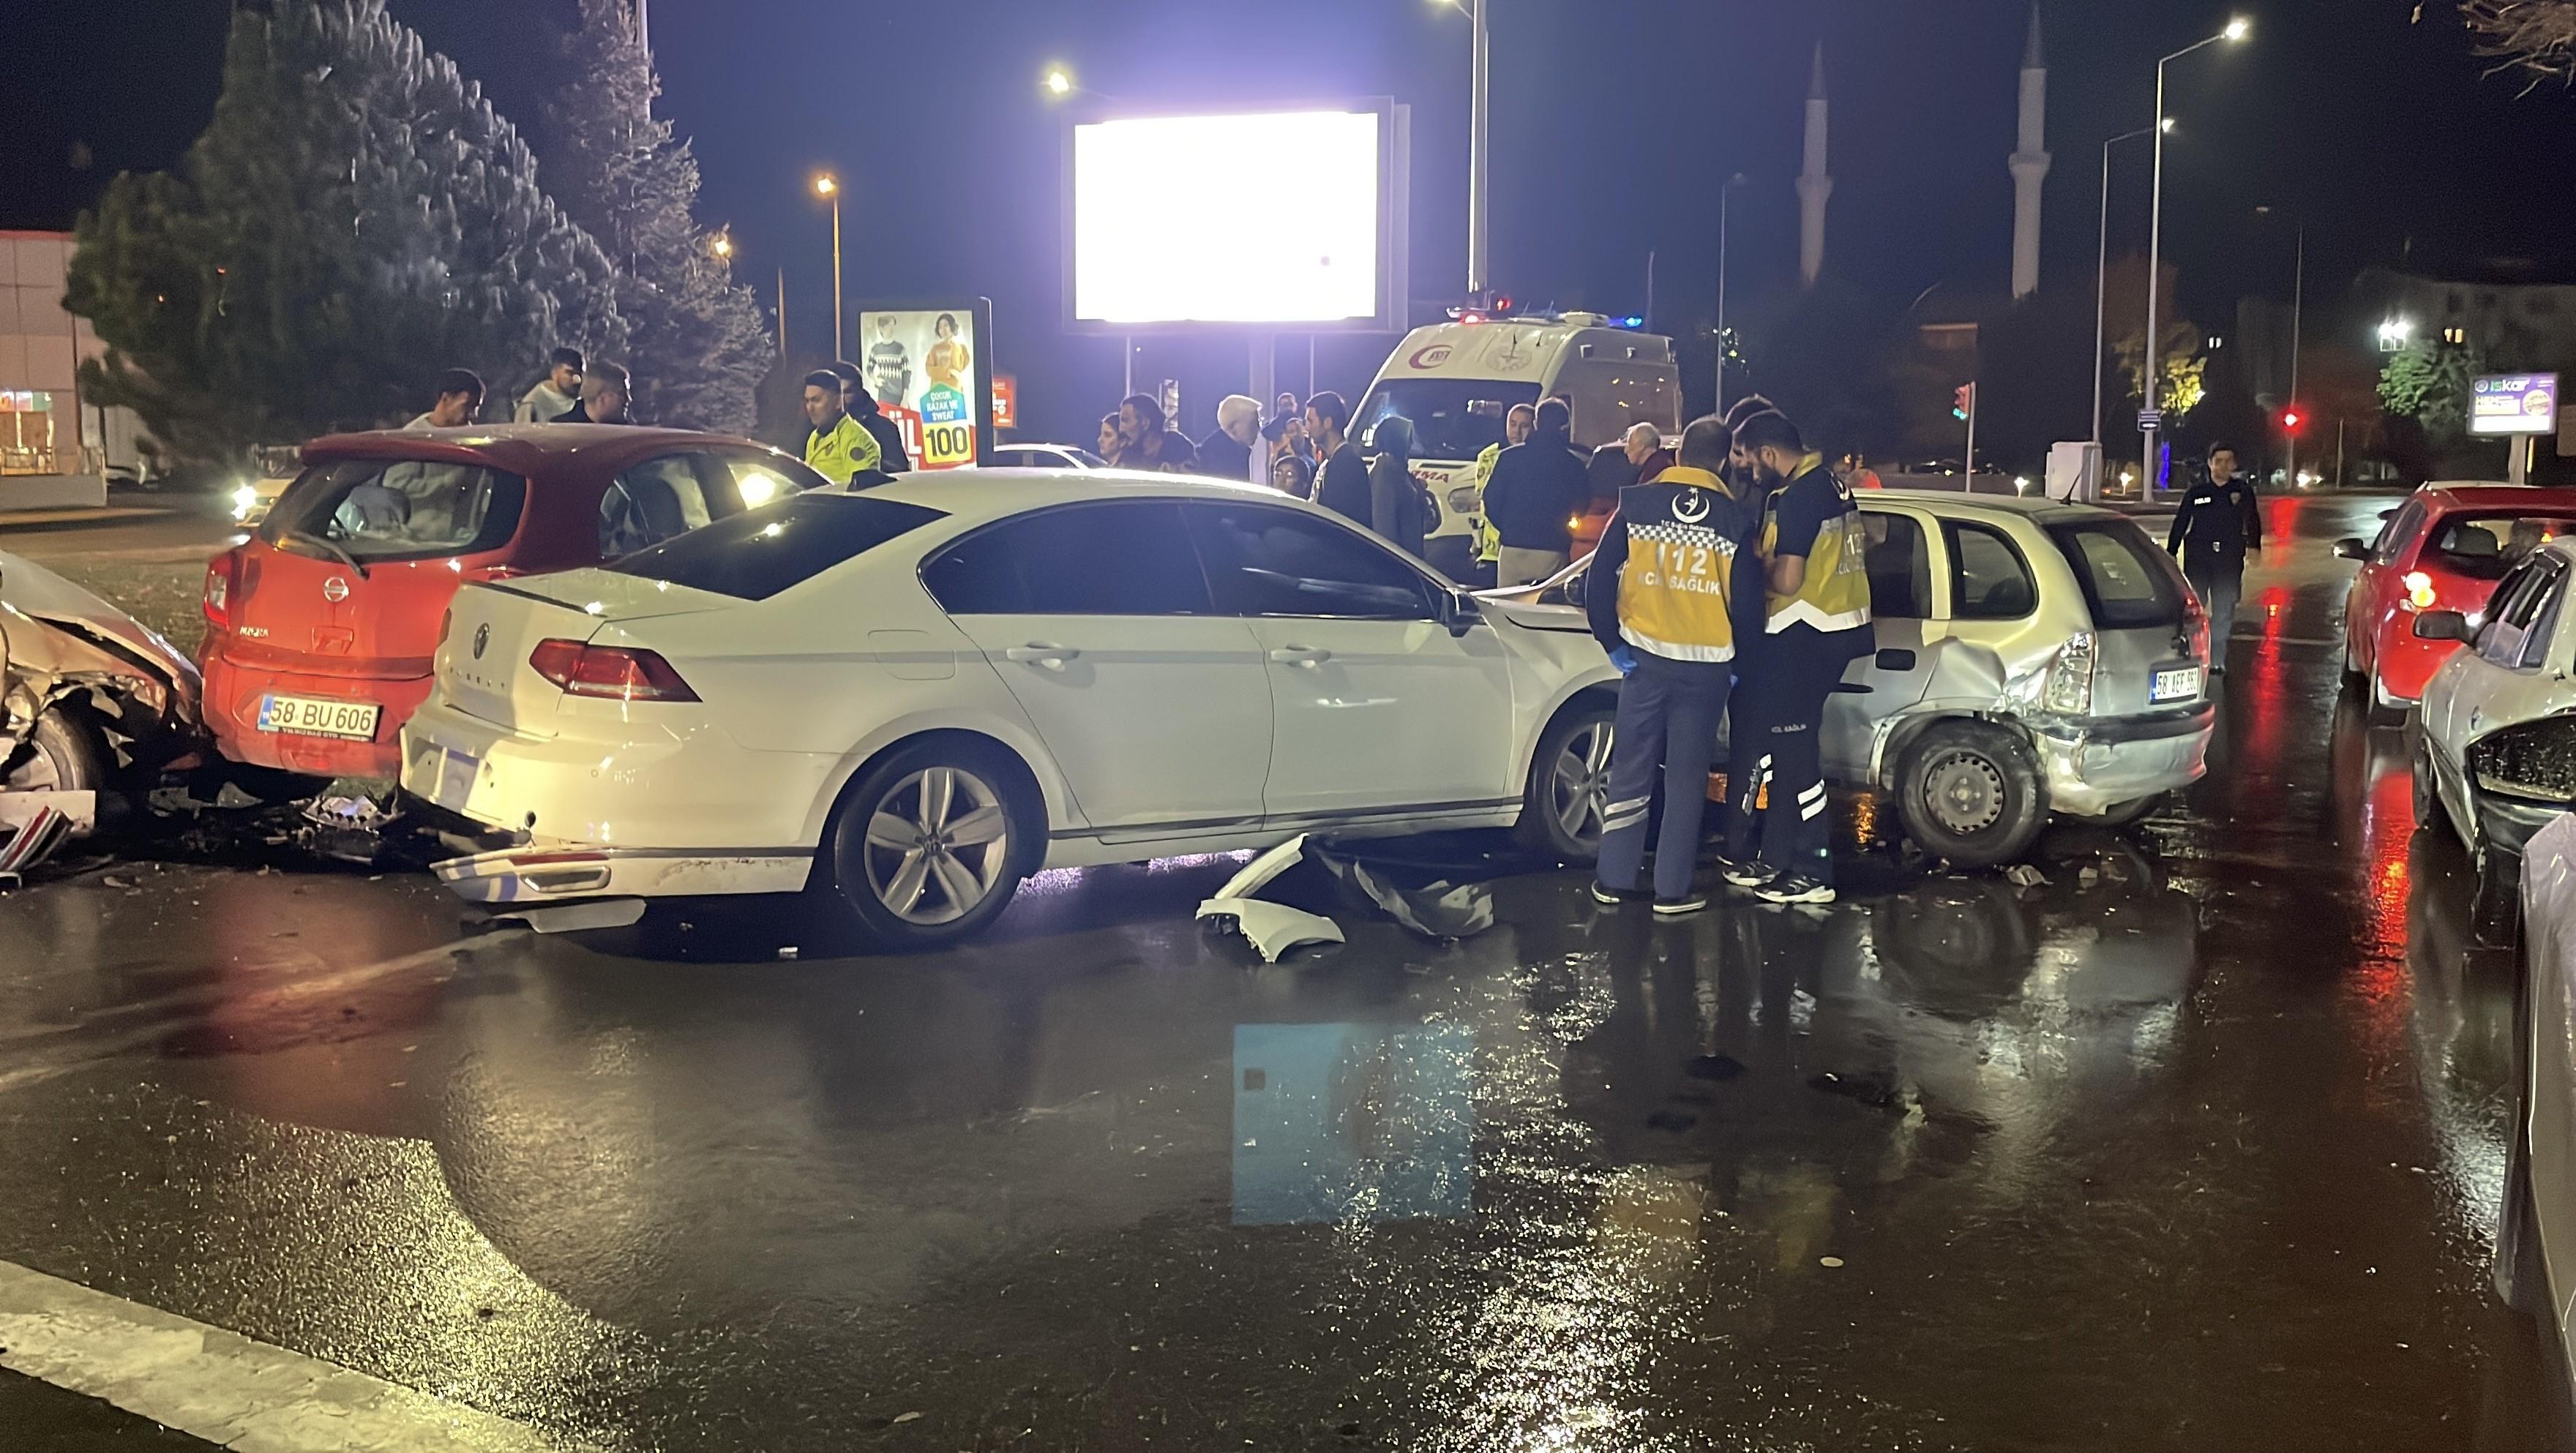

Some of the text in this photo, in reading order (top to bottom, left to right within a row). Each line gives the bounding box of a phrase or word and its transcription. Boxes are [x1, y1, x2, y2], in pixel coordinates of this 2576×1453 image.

[926, 402, 948, 412] KAZAK
[925, 426, 968, 457] 100
[1658, 542, 1708, 576] 112
[1669, 574, 1721, 595] SAĞLIK
[2157, 675, 2168, 695] 58
[270, 700, 372, 732] 58 BU 606
